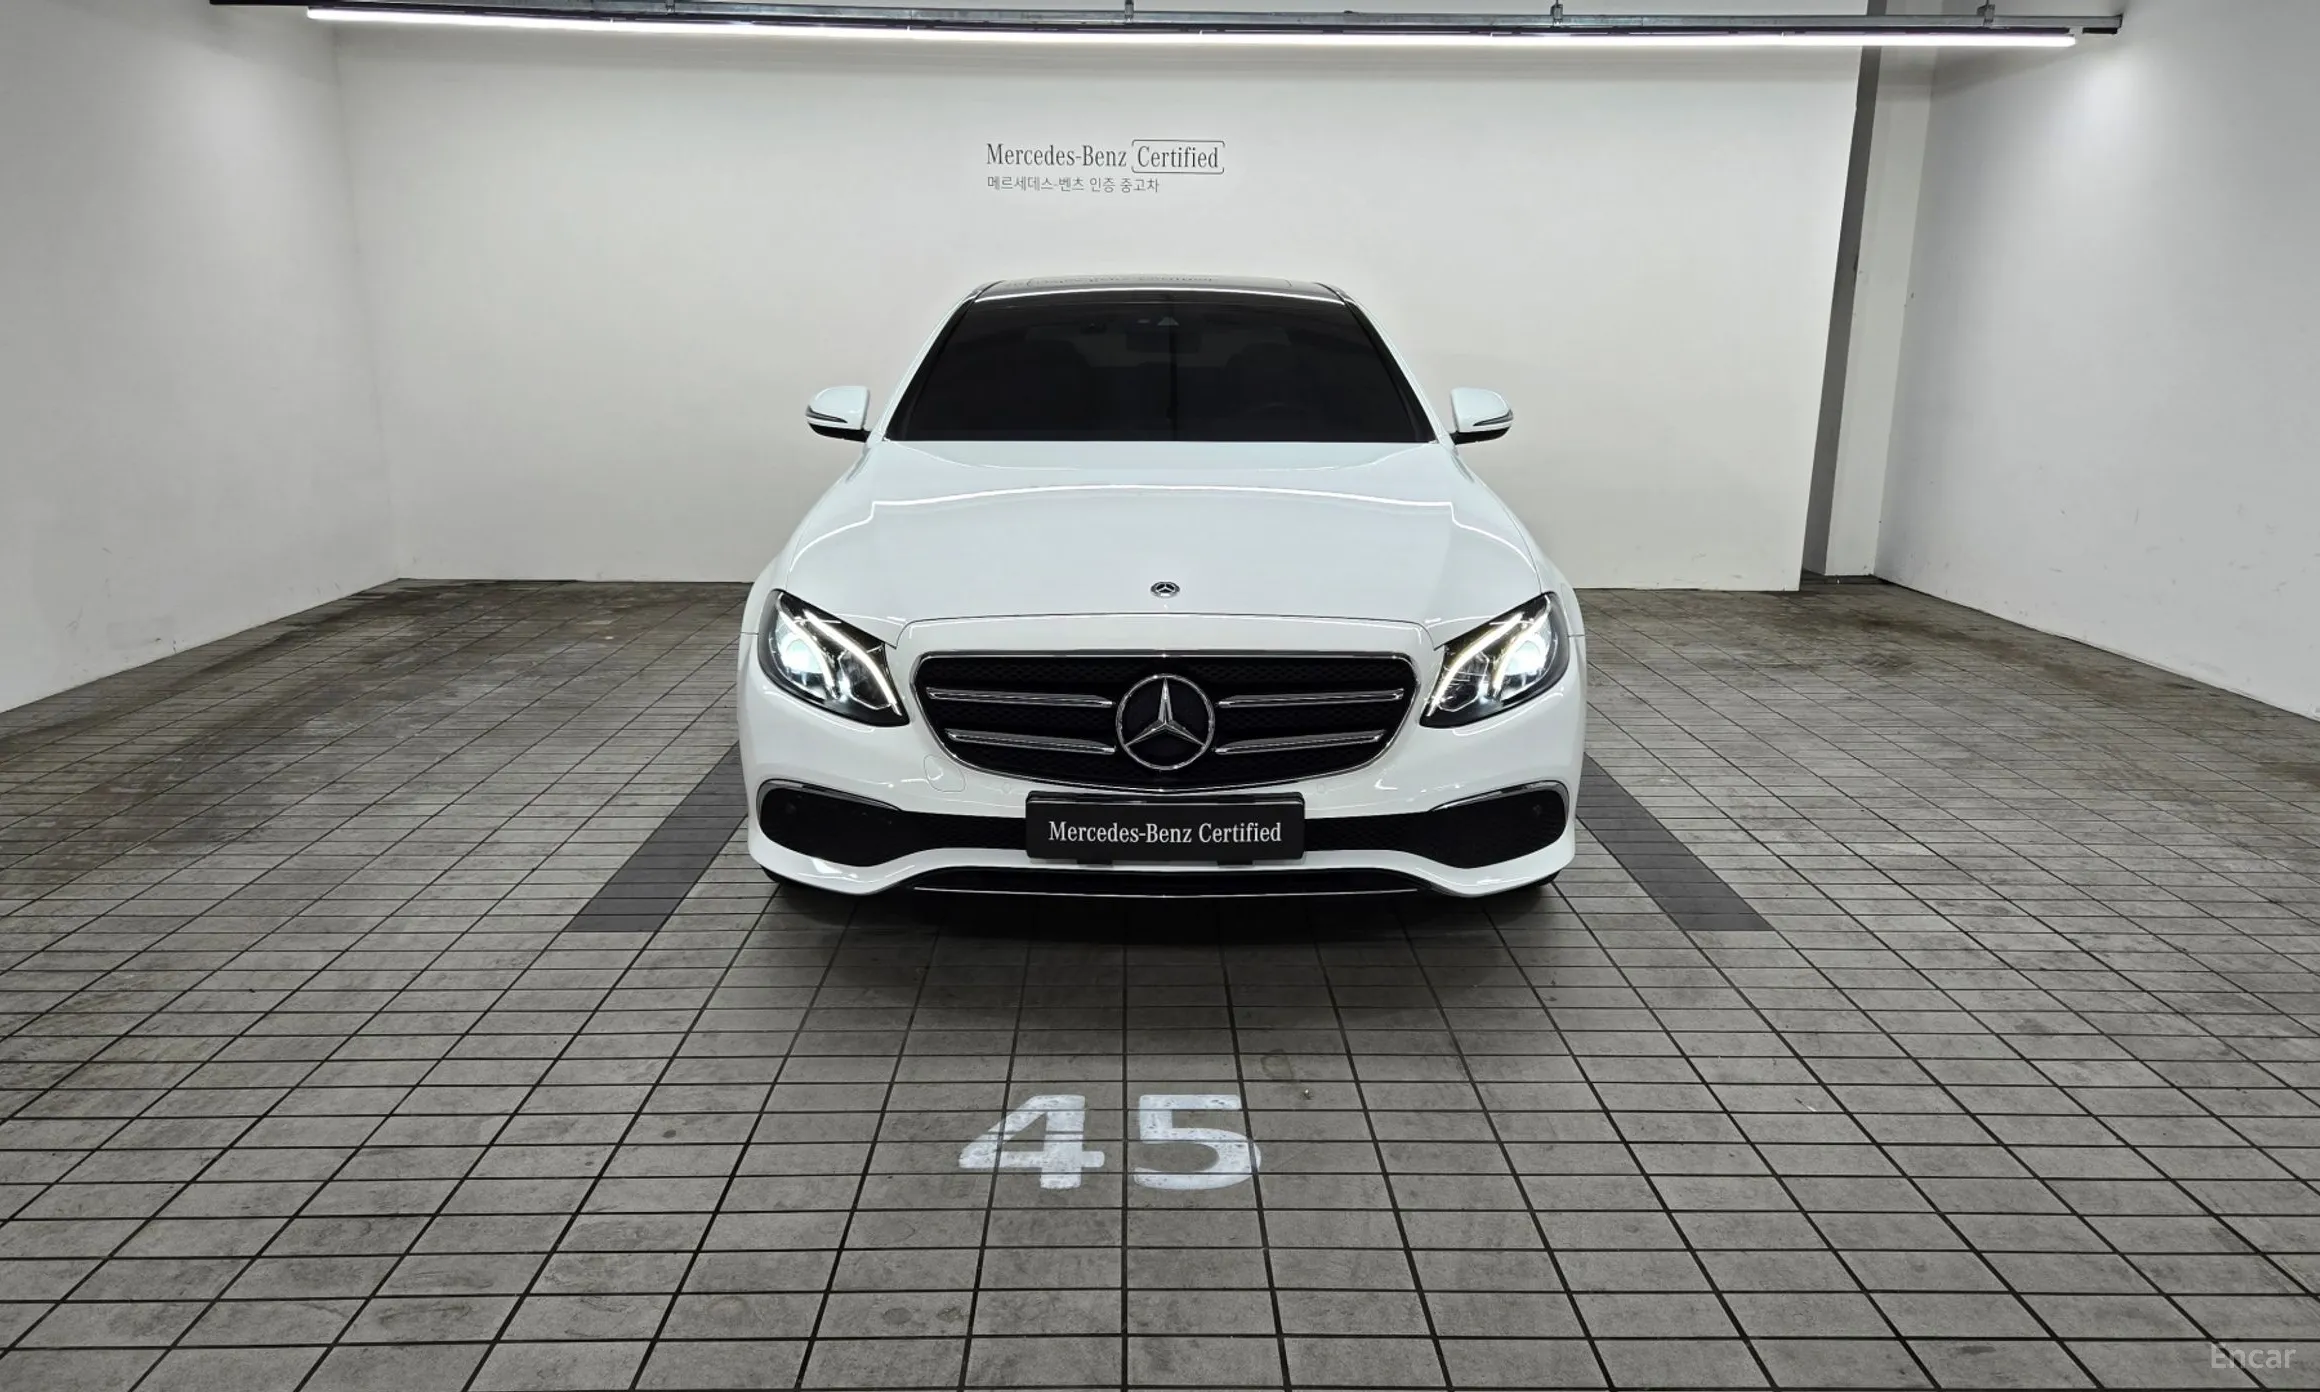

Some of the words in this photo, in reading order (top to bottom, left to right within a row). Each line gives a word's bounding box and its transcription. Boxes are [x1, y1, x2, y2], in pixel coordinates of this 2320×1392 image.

[986, 143, 1127, 167] Mercedes-Benz
[1137, 145, 1219, 168] Certified
[987, 176, 1085, 192] 메르세데스-벤츠
[1089, 177, 1116, 193] 인증
[1120, 177, 1160, 193] 중고차
[1049, 821, 1192, 843] Mercedes-Benz
[1199, 822, 1282, 843] Certified
[959, 1094, 1261, 1190] 45
